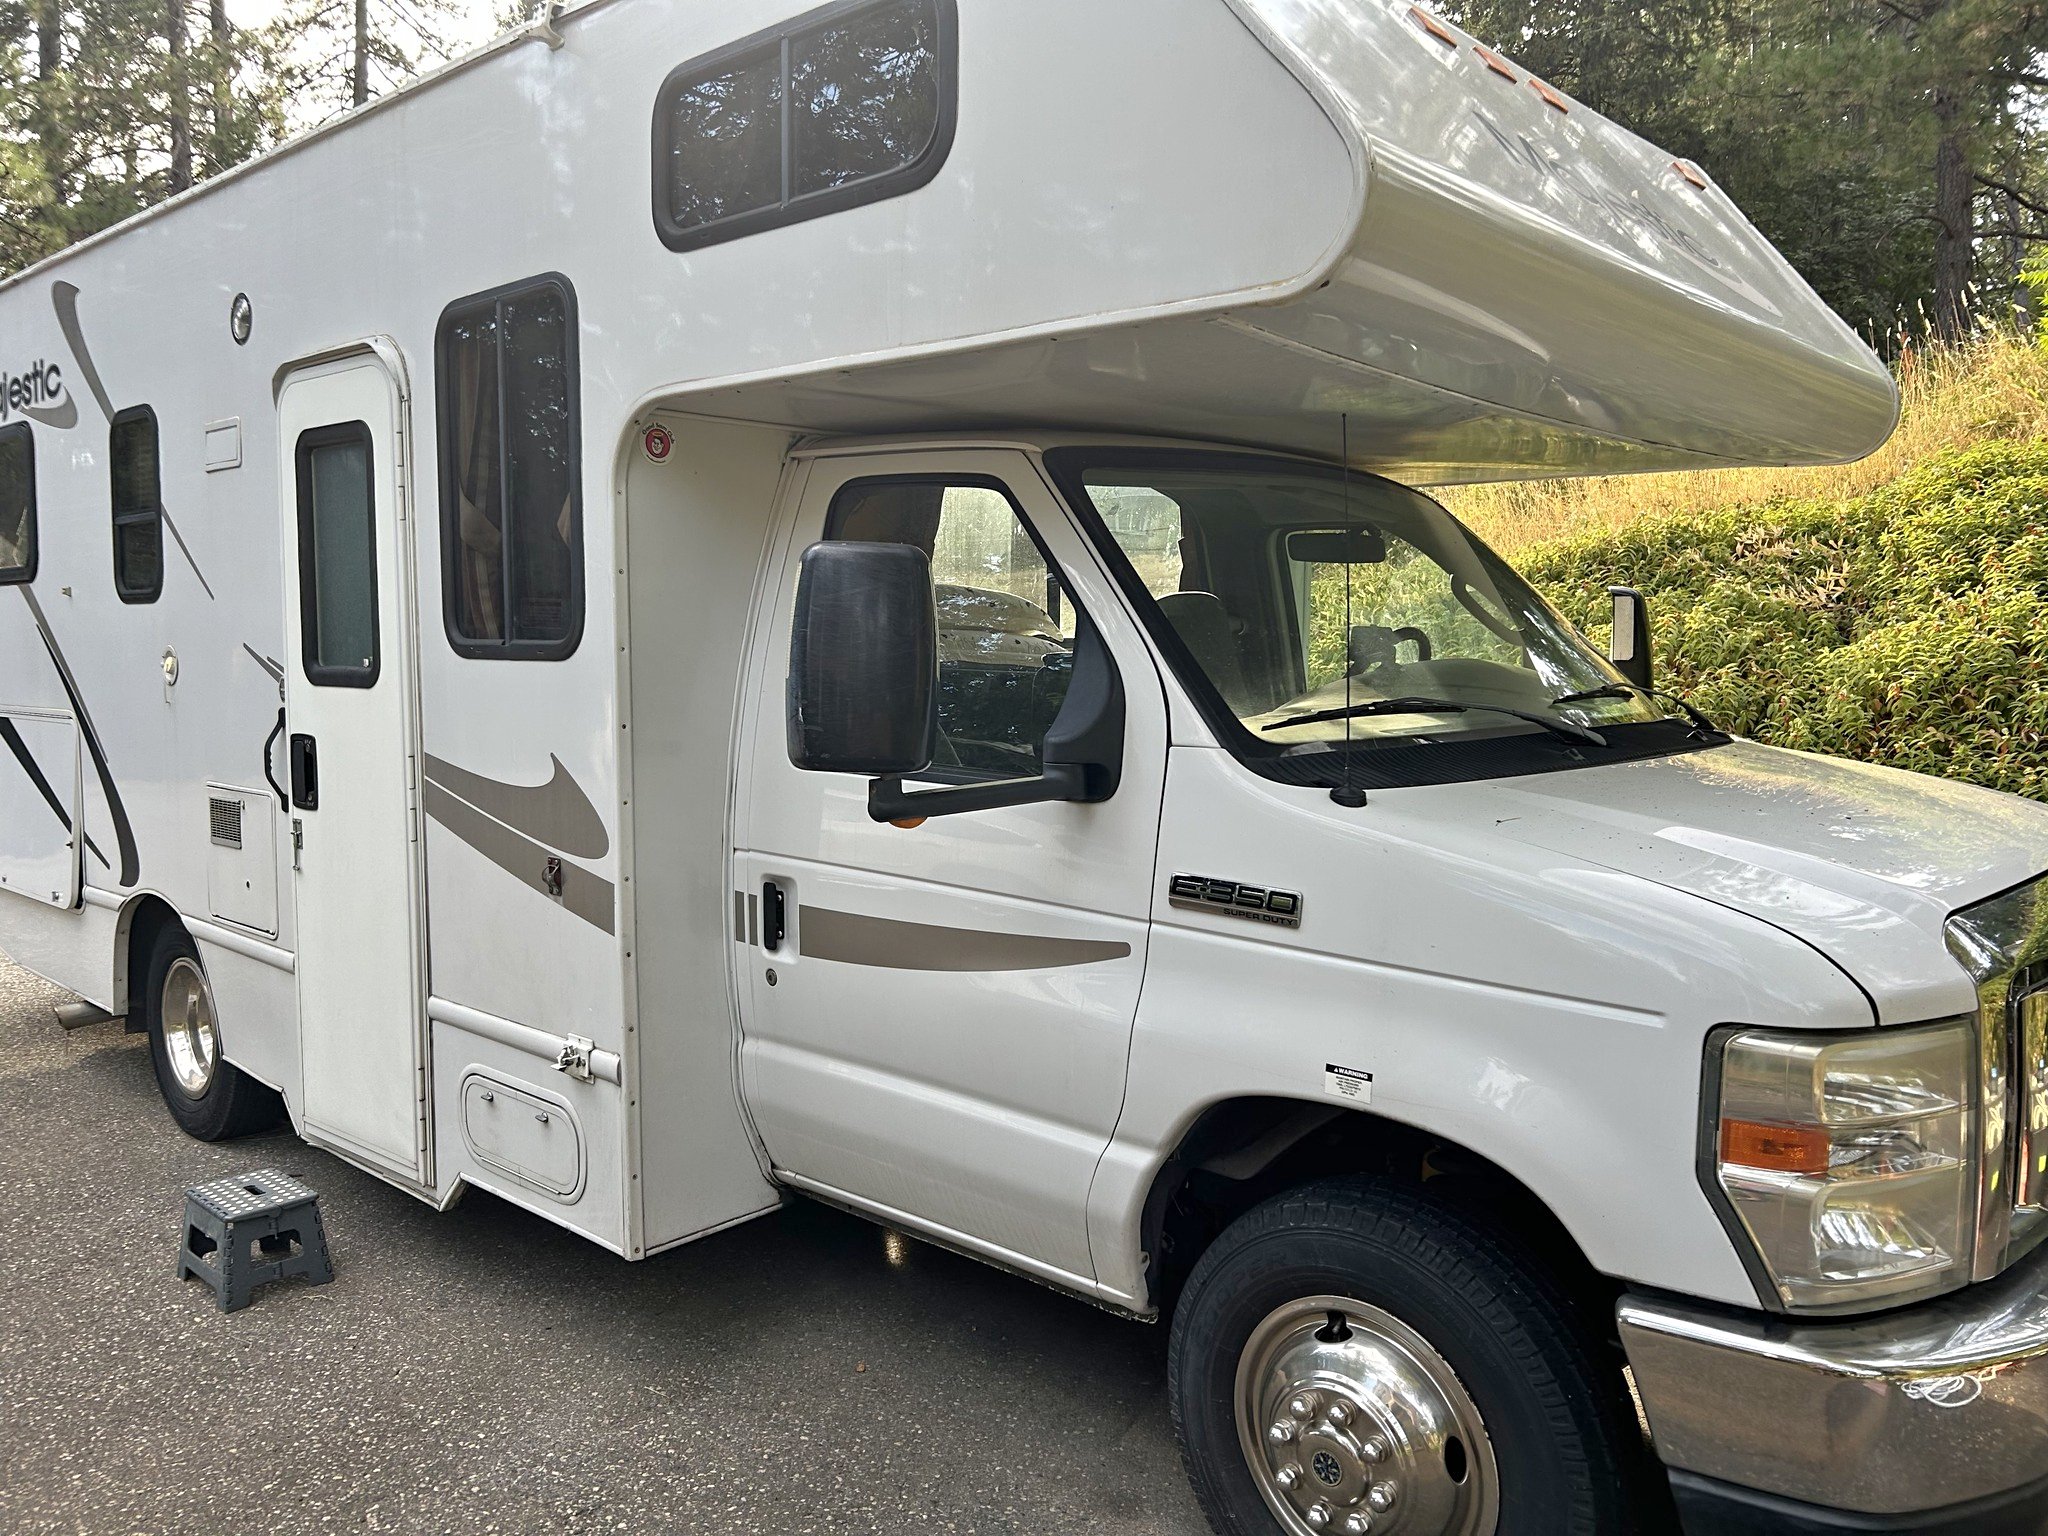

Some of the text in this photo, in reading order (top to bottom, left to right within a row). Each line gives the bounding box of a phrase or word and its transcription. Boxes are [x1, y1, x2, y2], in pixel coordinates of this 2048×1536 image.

[0, 358, 62, 421] jestic
[1223, 908, 1294, 926] SUPER DUTY
[1338, 1067, 1369, 1080] WARNING
